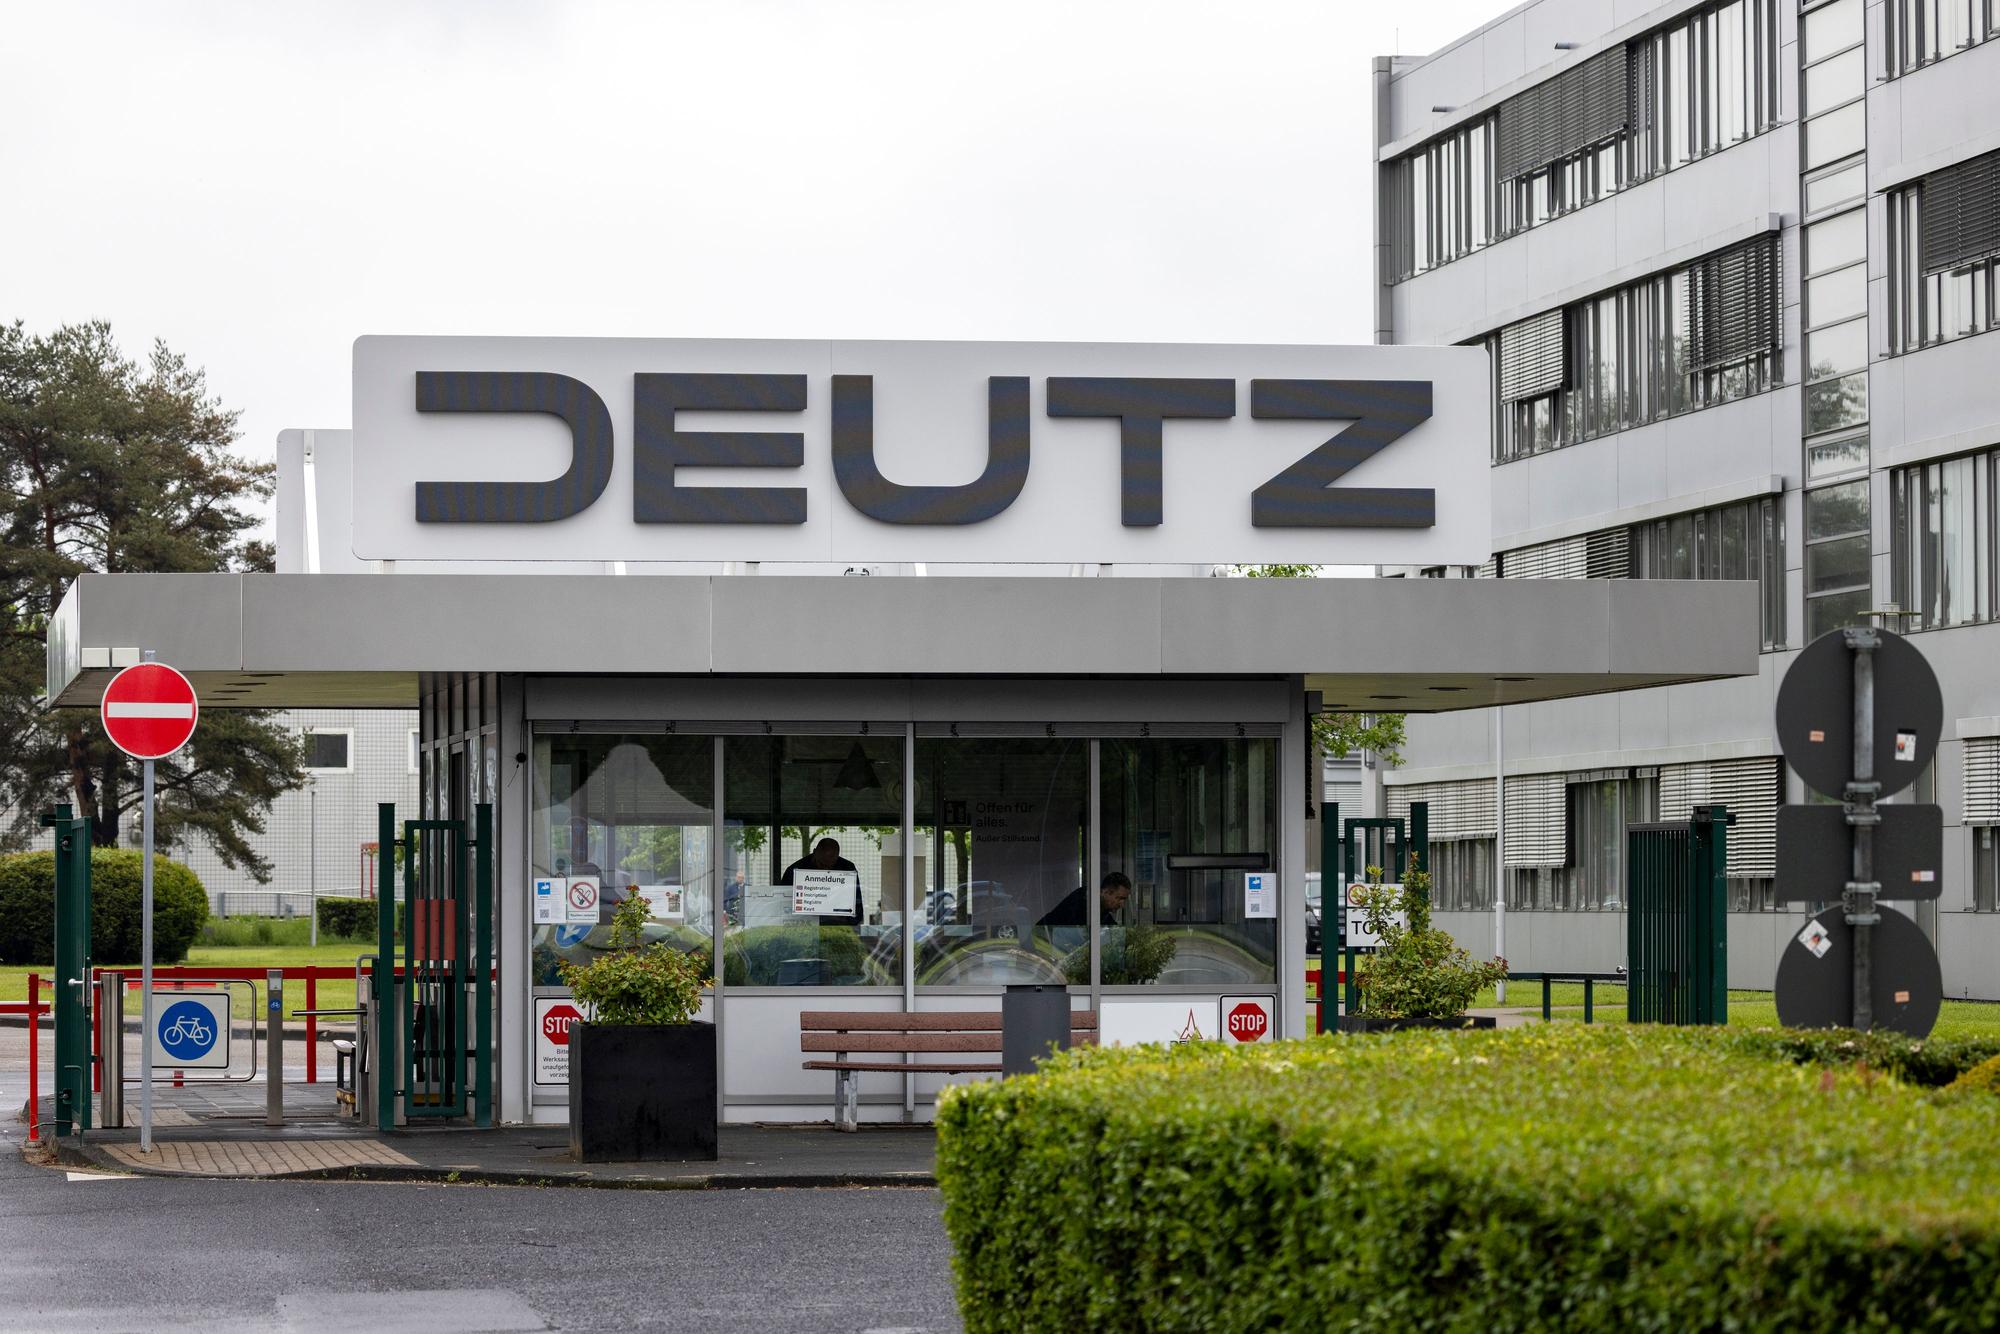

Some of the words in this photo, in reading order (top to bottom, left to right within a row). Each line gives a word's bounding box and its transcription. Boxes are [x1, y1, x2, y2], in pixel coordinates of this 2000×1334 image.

[415, 371, 1436, 527] DEUTZ
[975, 802, 1012, 813] Offen
[1014, 801, 1035, 813] für
[975, 816, 1008, 828] alles.
[804, 875, 846, 884] Anmeldung
[545, 1016, 580, 1034] STO
[1231, 1014, 1265, 1031] STOP
